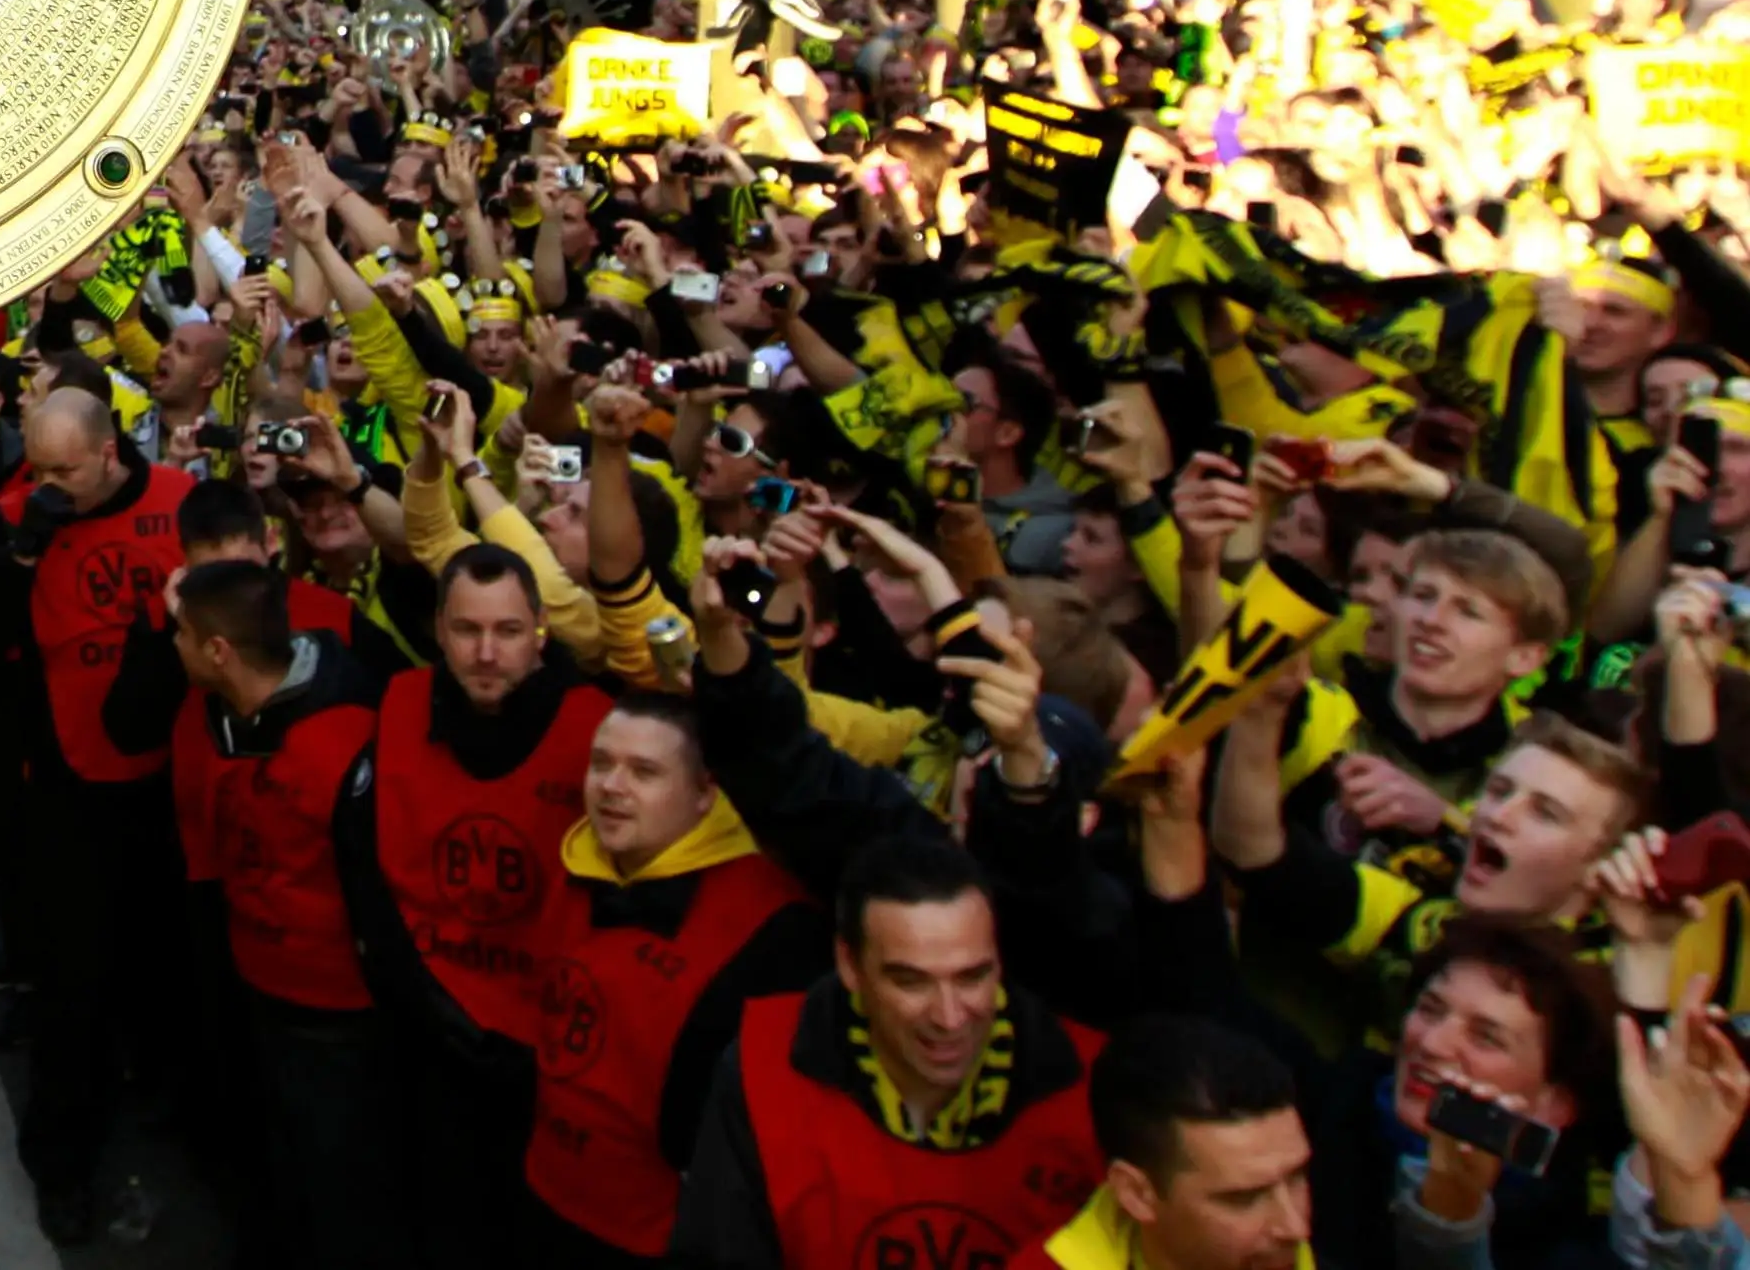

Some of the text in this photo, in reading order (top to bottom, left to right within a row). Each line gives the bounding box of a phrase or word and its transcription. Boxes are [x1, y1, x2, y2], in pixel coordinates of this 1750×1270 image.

[192, 21, 207, 39] FC
[50, 44, 95, 99] SCHALKE
[145, 1, 234, 160] 1990 FC BAYERN MÜNCHEN
[169, 38, 199, 86] BAYERN
[38, 91, 56, 110] 04
[132, 84, 177, 145] MÜNCHEN
[48, 211, 66, 230] FC
[62, 192, 89, 219] 2006
[77, 206, 103, 231] 1991
[4, 223, 51, 261] BAYERN
[447, 826, 526, 892] BVB
